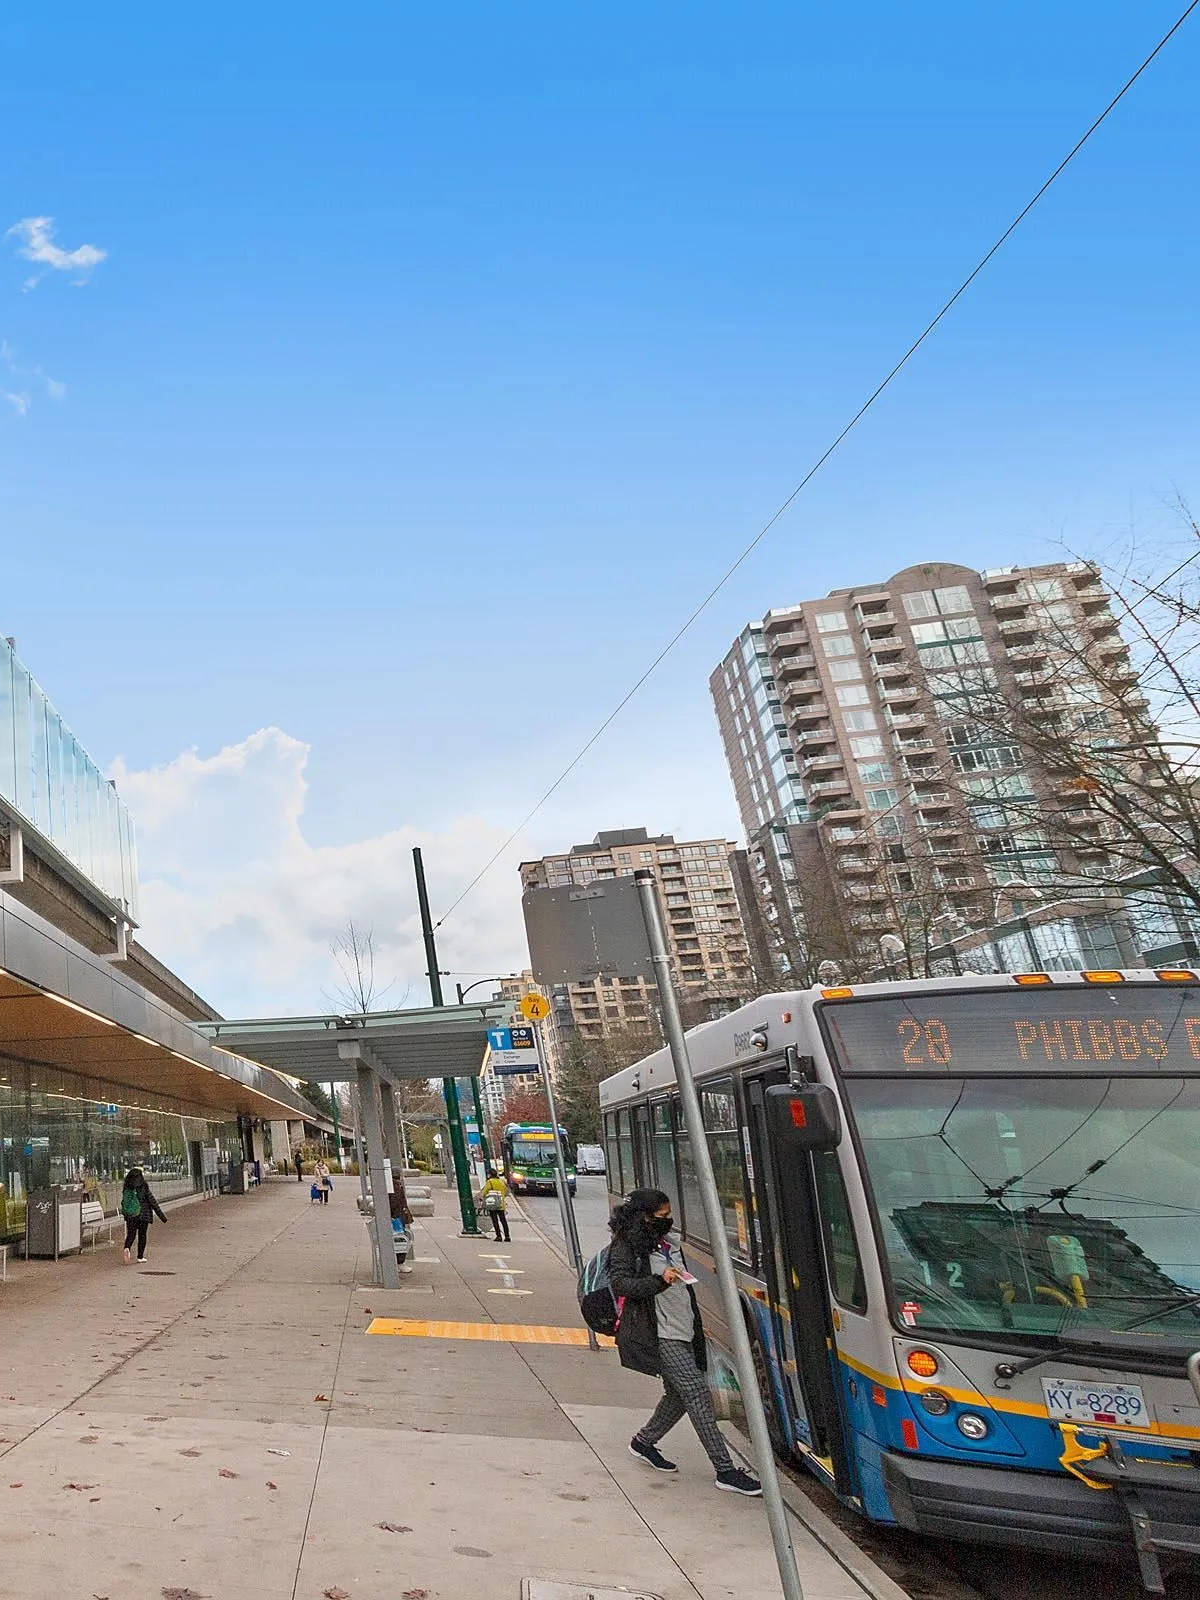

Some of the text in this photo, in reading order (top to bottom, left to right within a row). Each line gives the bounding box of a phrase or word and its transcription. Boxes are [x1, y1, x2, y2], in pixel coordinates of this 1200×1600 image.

[530, 1004, 540, 1016] 4
[898, 1019, 951, 1064] 28
[1014, 1018, 1169, 1061] PHIBBS
[1047, 1389, 1141, 1416] KY 8289
